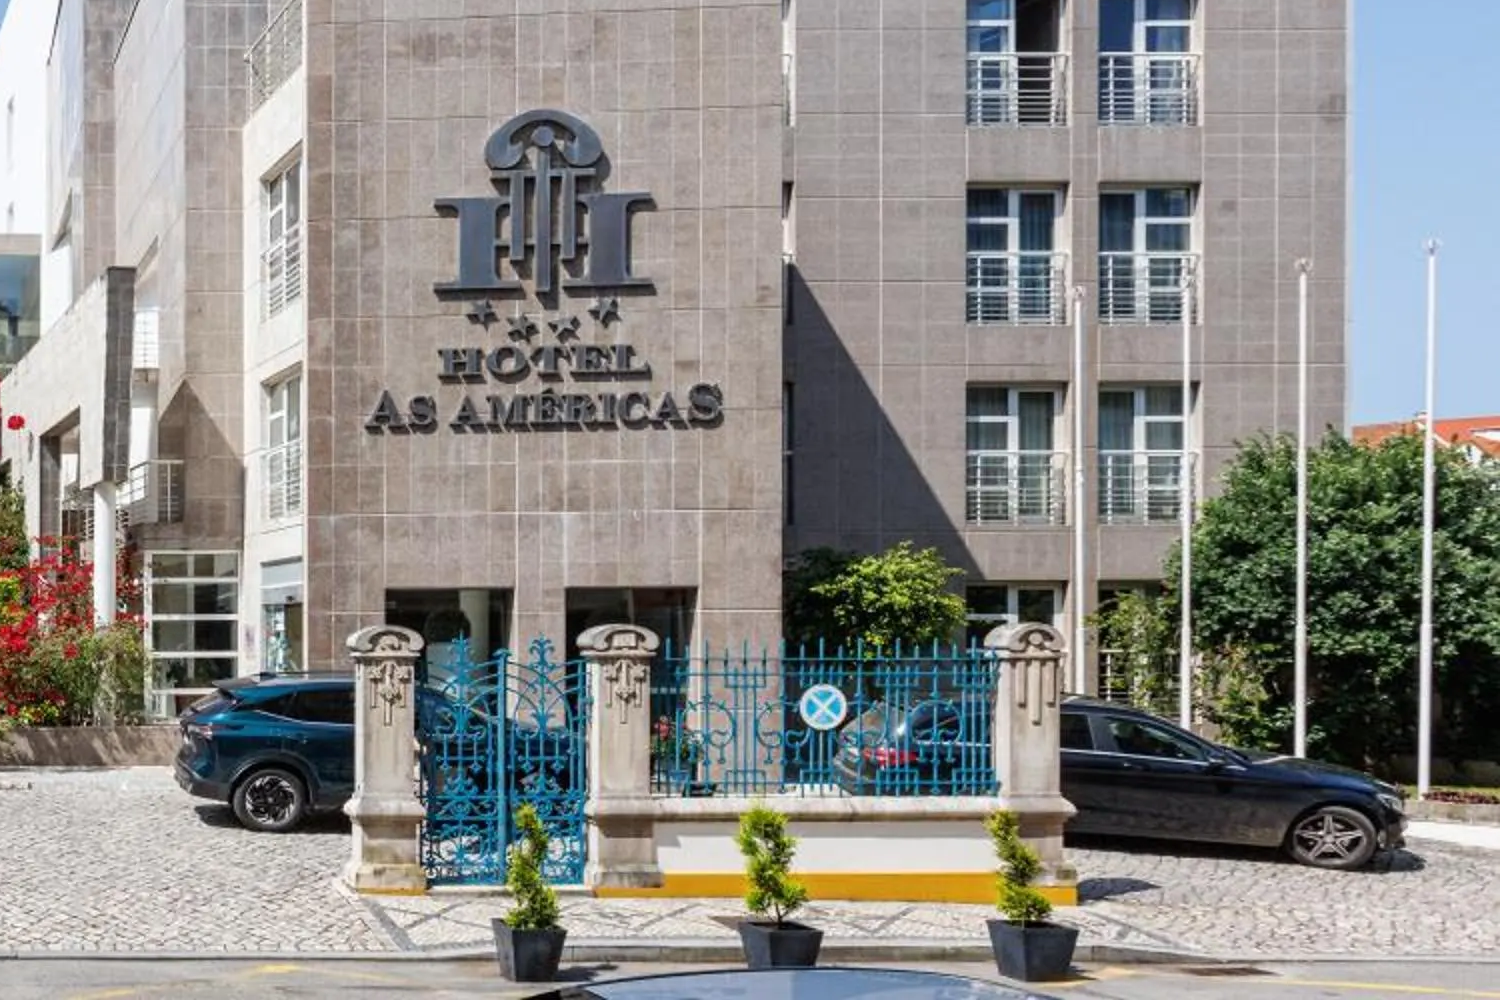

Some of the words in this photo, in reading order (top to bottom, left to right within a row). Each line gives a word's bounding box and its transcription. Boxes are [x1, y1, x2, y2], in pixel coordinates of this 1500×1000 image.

[438, 344, 652, 383] HOTEL
[365, 390, 437, 434] AS
[451, 383, 723, 432] AMÉRICAS
